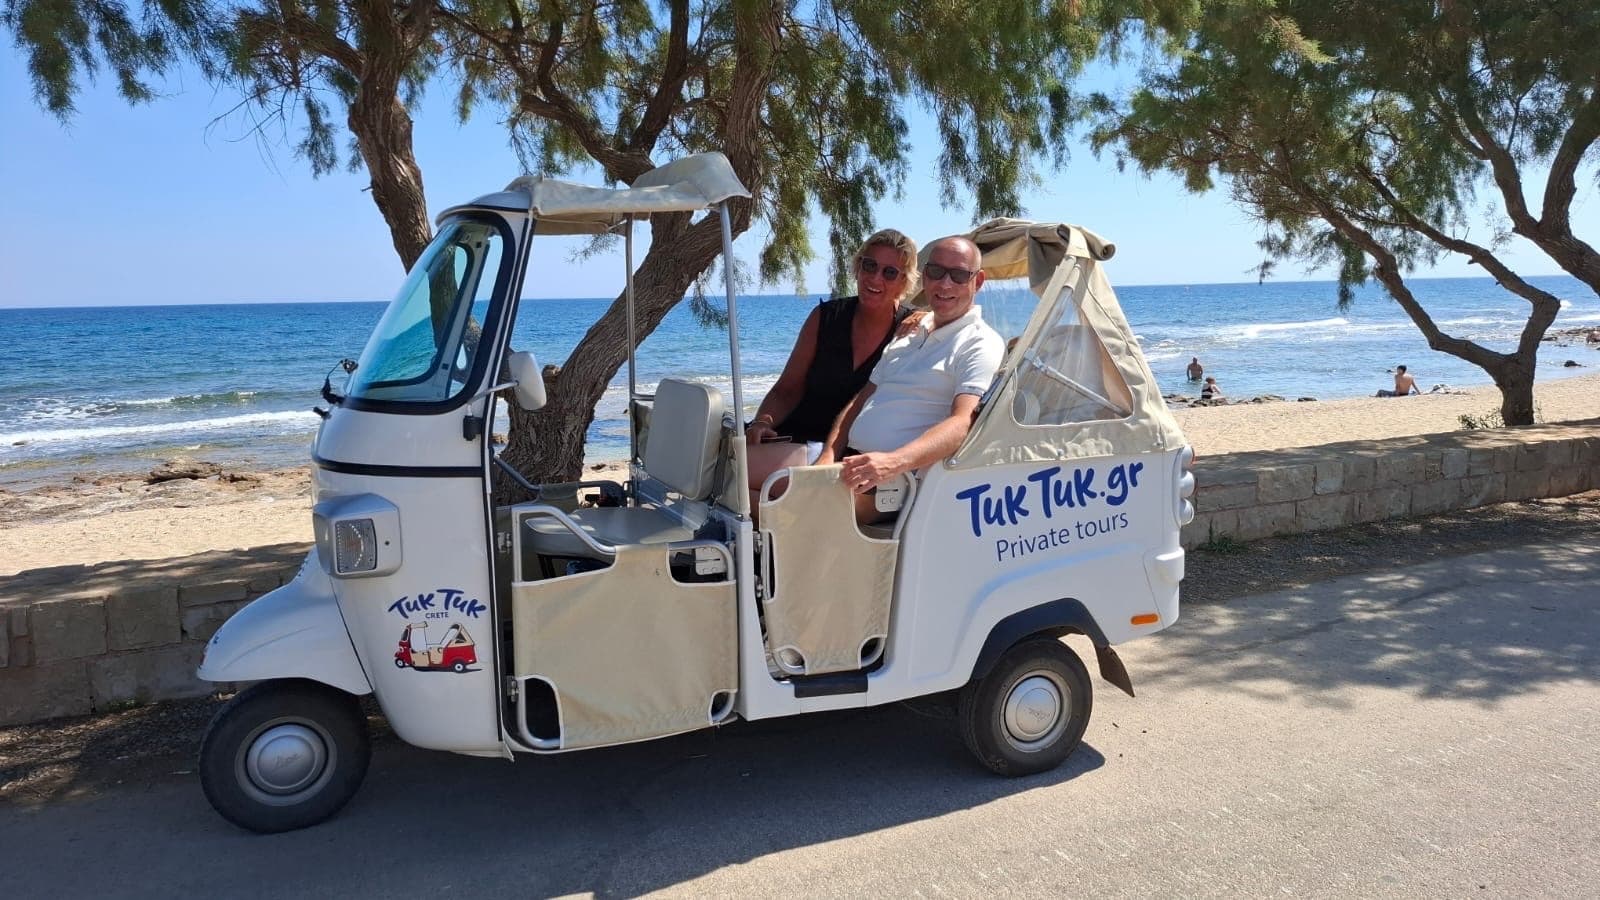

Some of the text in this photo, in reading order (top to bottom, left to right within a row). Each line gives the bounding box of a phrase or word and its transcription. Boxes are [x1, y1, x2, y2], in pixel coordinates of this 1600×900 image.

[996, 512, 1129, 562] Private tours
[425, 611, 449, 619] CRETE
